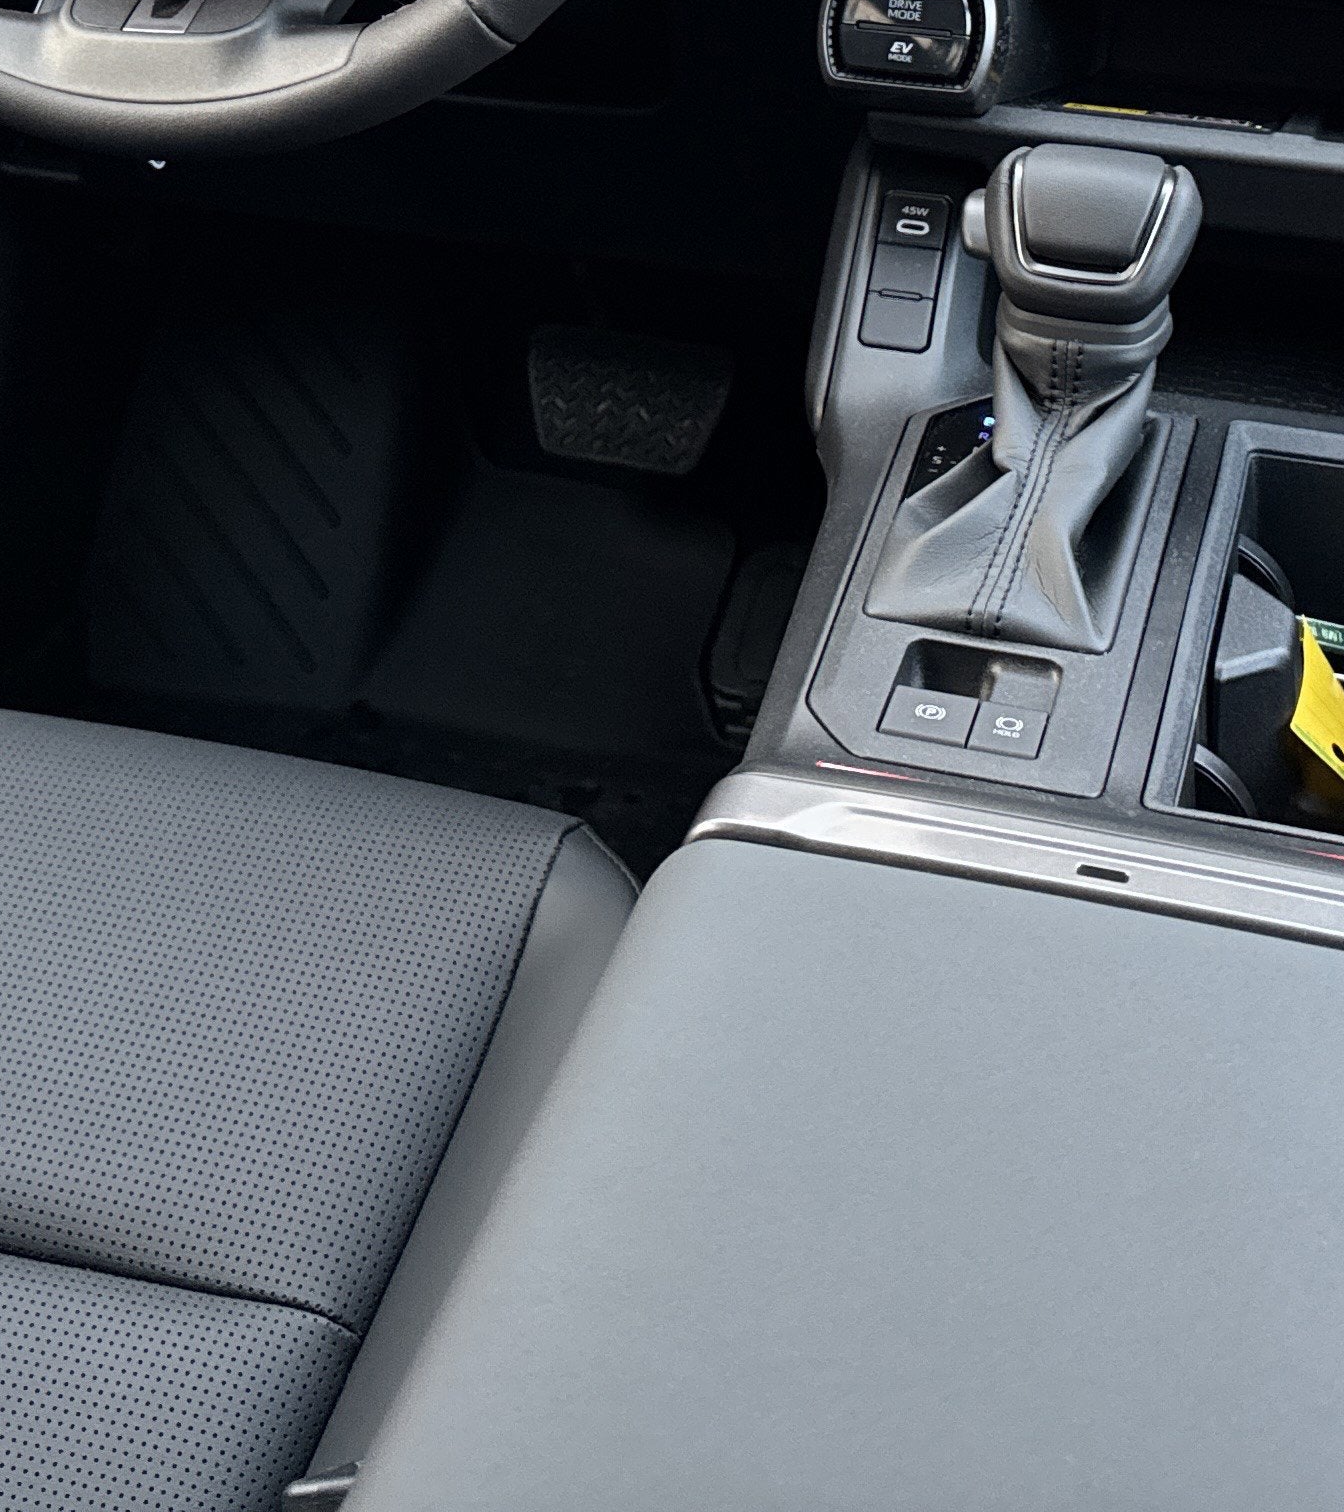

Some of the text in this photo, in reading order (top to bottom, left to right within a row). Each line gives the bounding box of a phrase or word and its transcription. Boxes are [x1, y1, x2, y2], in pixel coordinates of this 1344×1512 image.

[887, 9, 922, 22] MODE
[890, 41, 914, 54] EV
[901, 204, 930, 217] 45W
